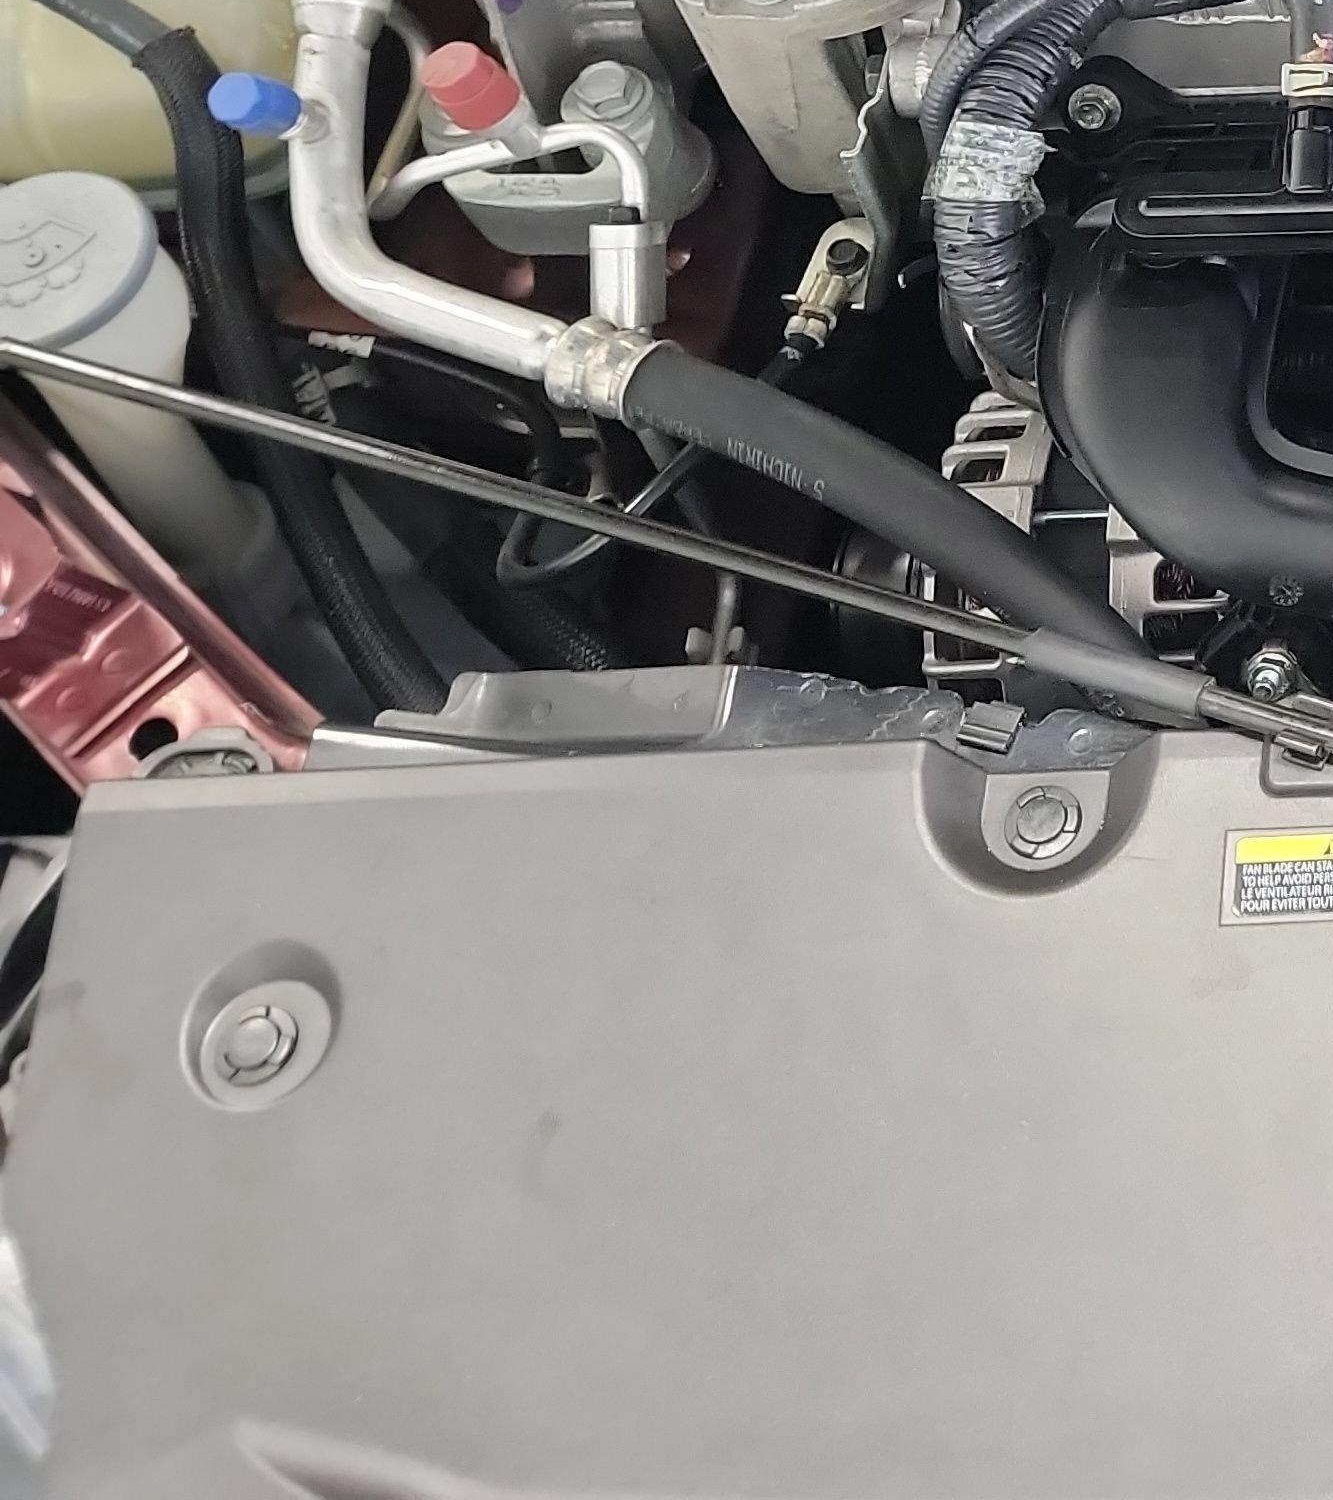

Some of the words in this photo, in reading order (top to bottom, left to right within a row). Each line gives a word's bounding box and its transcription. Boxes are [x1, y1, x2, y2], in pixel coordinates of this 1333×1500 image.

[1242, 864, 1262, 875] FAN
[1294, 861, 1314, 873] CAN
[1242, 875, 1256, 887] TO
[1257, 874, 1281, 886] HELP
[1282, 873, 1312, 886] AVOID
[1241, 888, 1253, 899] LE
[1254, 884, 1322, 899] VENTILATEUR
[1240, 899, 1270, 913] POUR
